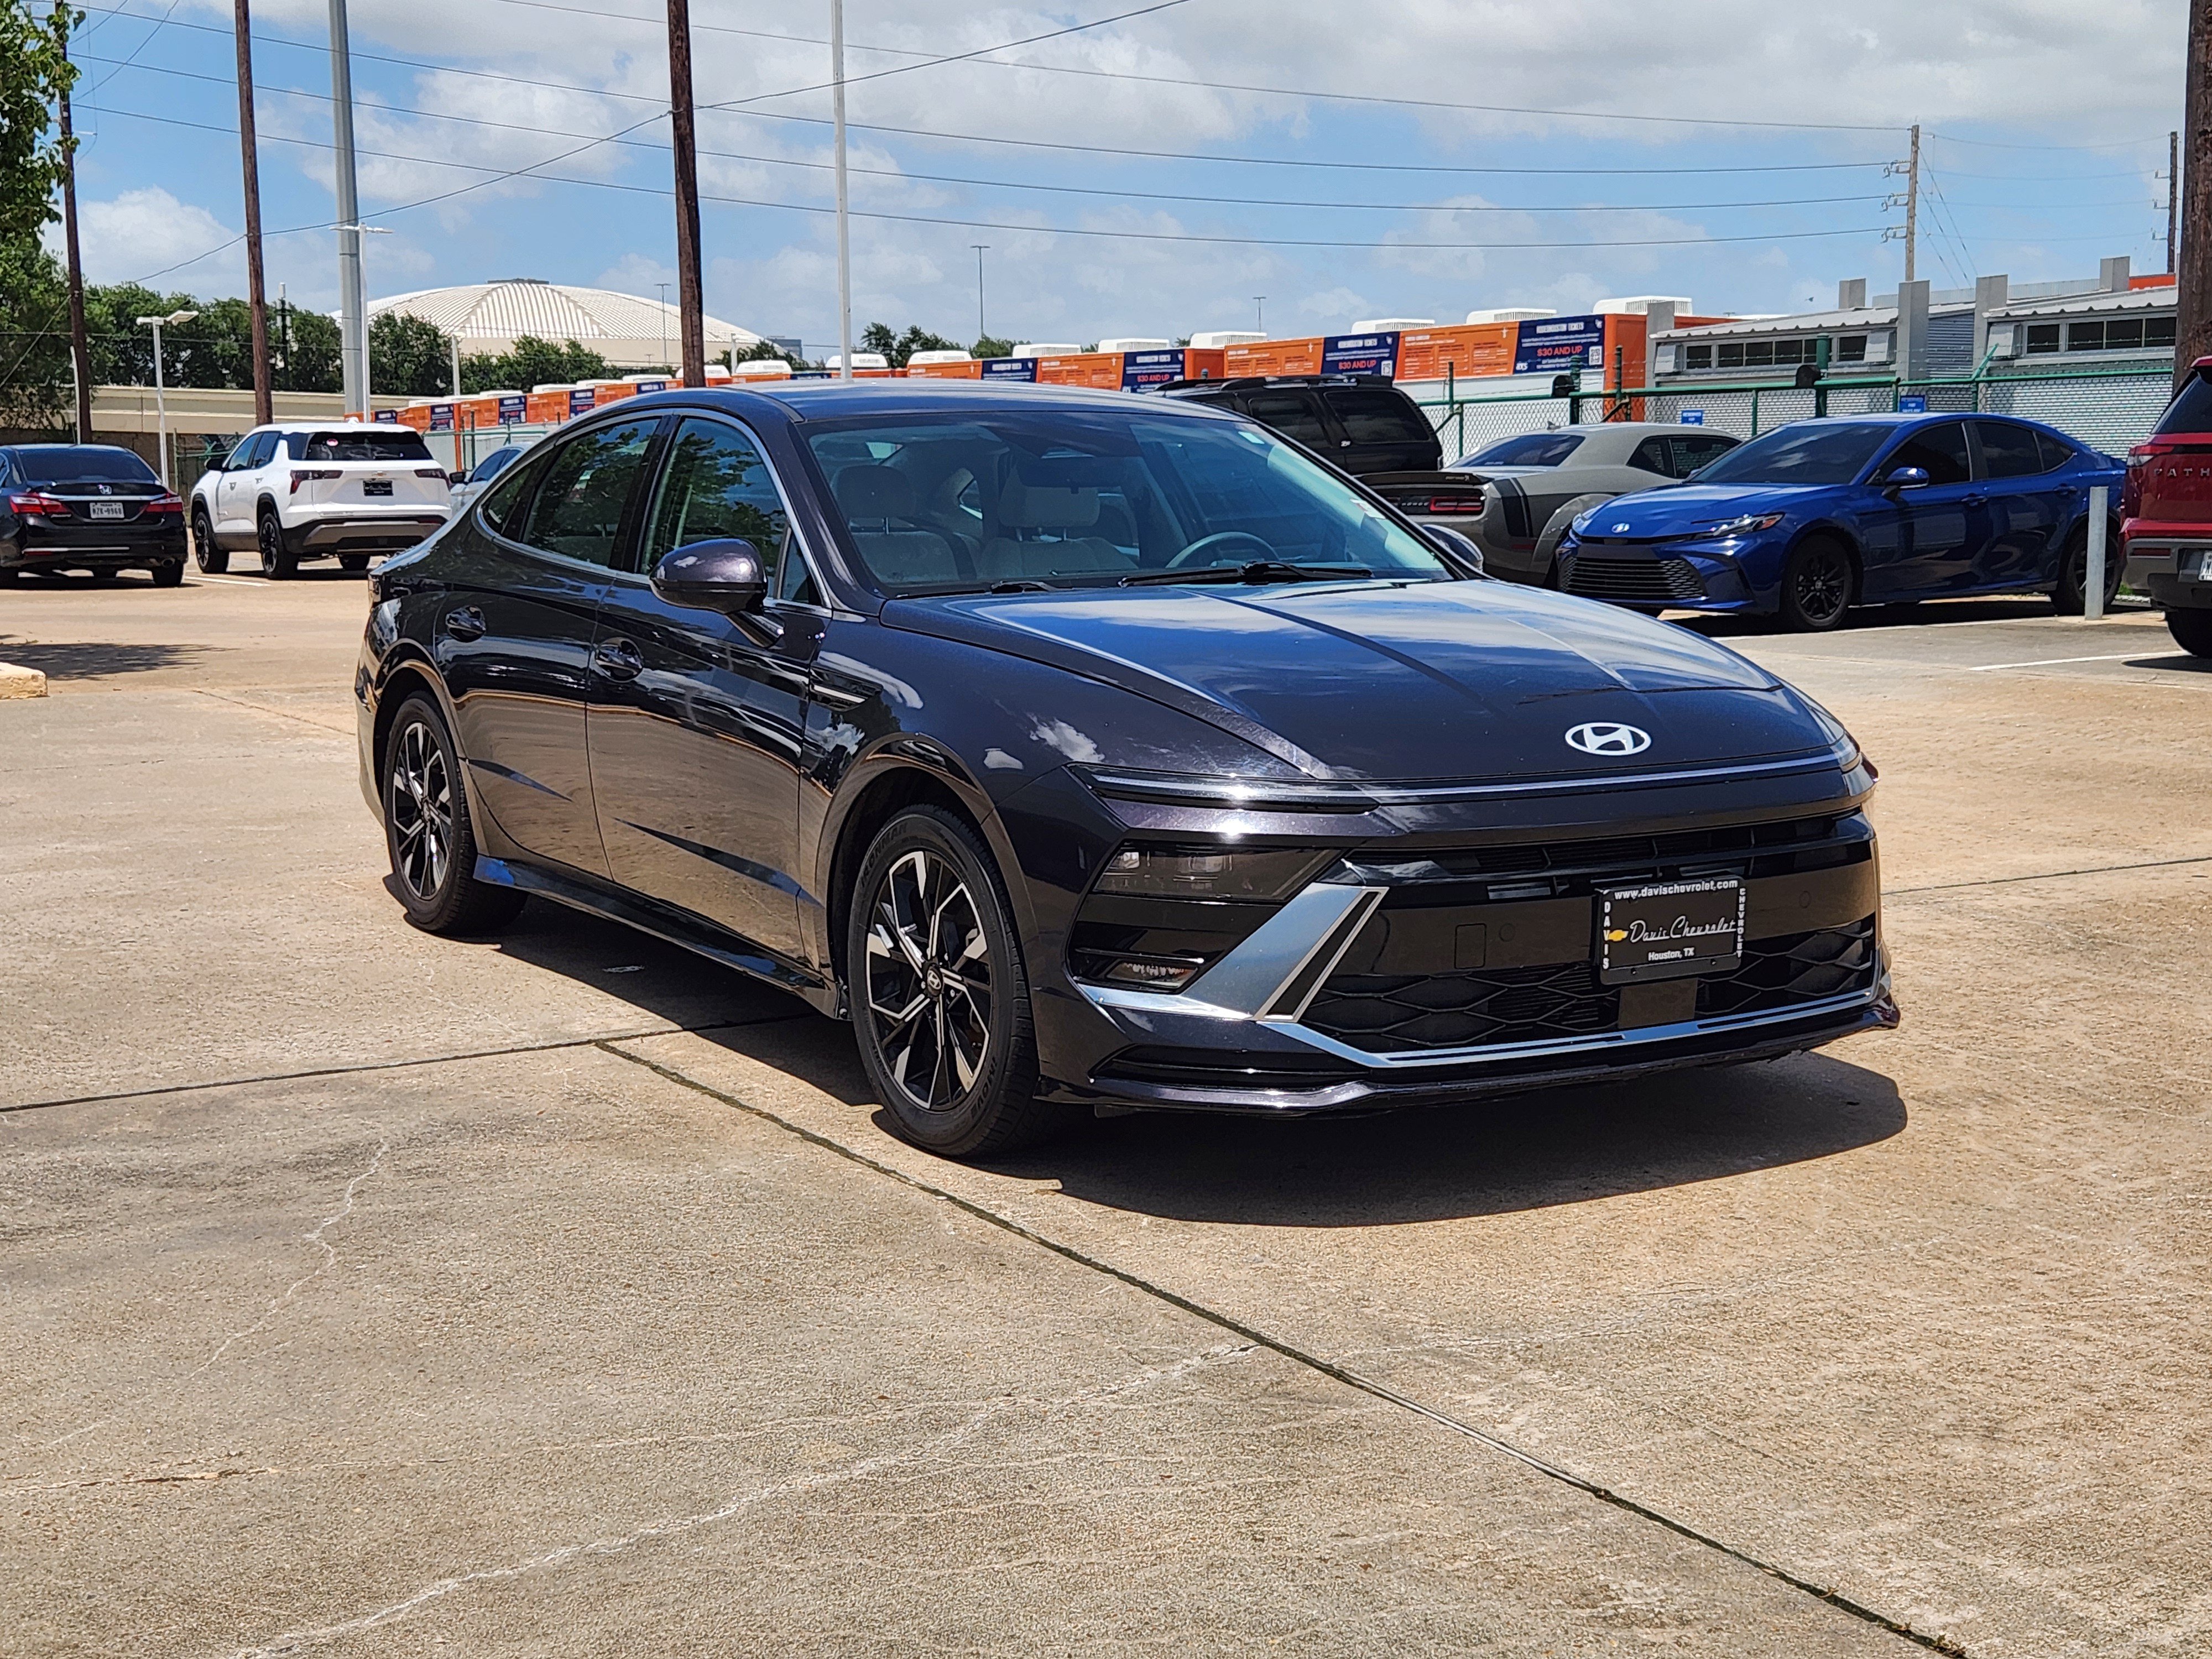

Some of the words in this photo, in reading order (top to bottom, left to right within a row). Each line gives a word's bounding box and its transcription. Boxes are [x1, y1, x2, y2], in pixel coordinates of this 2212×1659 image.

[1537, 347, 1553, 357] $30
[1553, 346, 1571, 356] AND
[1571, 345, 1583, 354] UP
[1352, 361, 1366, 369] AND
[1366, 359, 1376, 368] UP
[860, 822, 908, 887] IRONMAN
[1614, 880, 1738, 900] www.davischevrolet.com
[1630, 919, 1671, 943] Davis
[1670, 915, 1736, 938] Chevrolet
[1736, 888, 1746, 957] CHEVROLET
[1602, 901, 1611, 969] DAVIS
[1648, 948, 1682, 961] Houston,
[1683, 947, 1695, 957] TX
